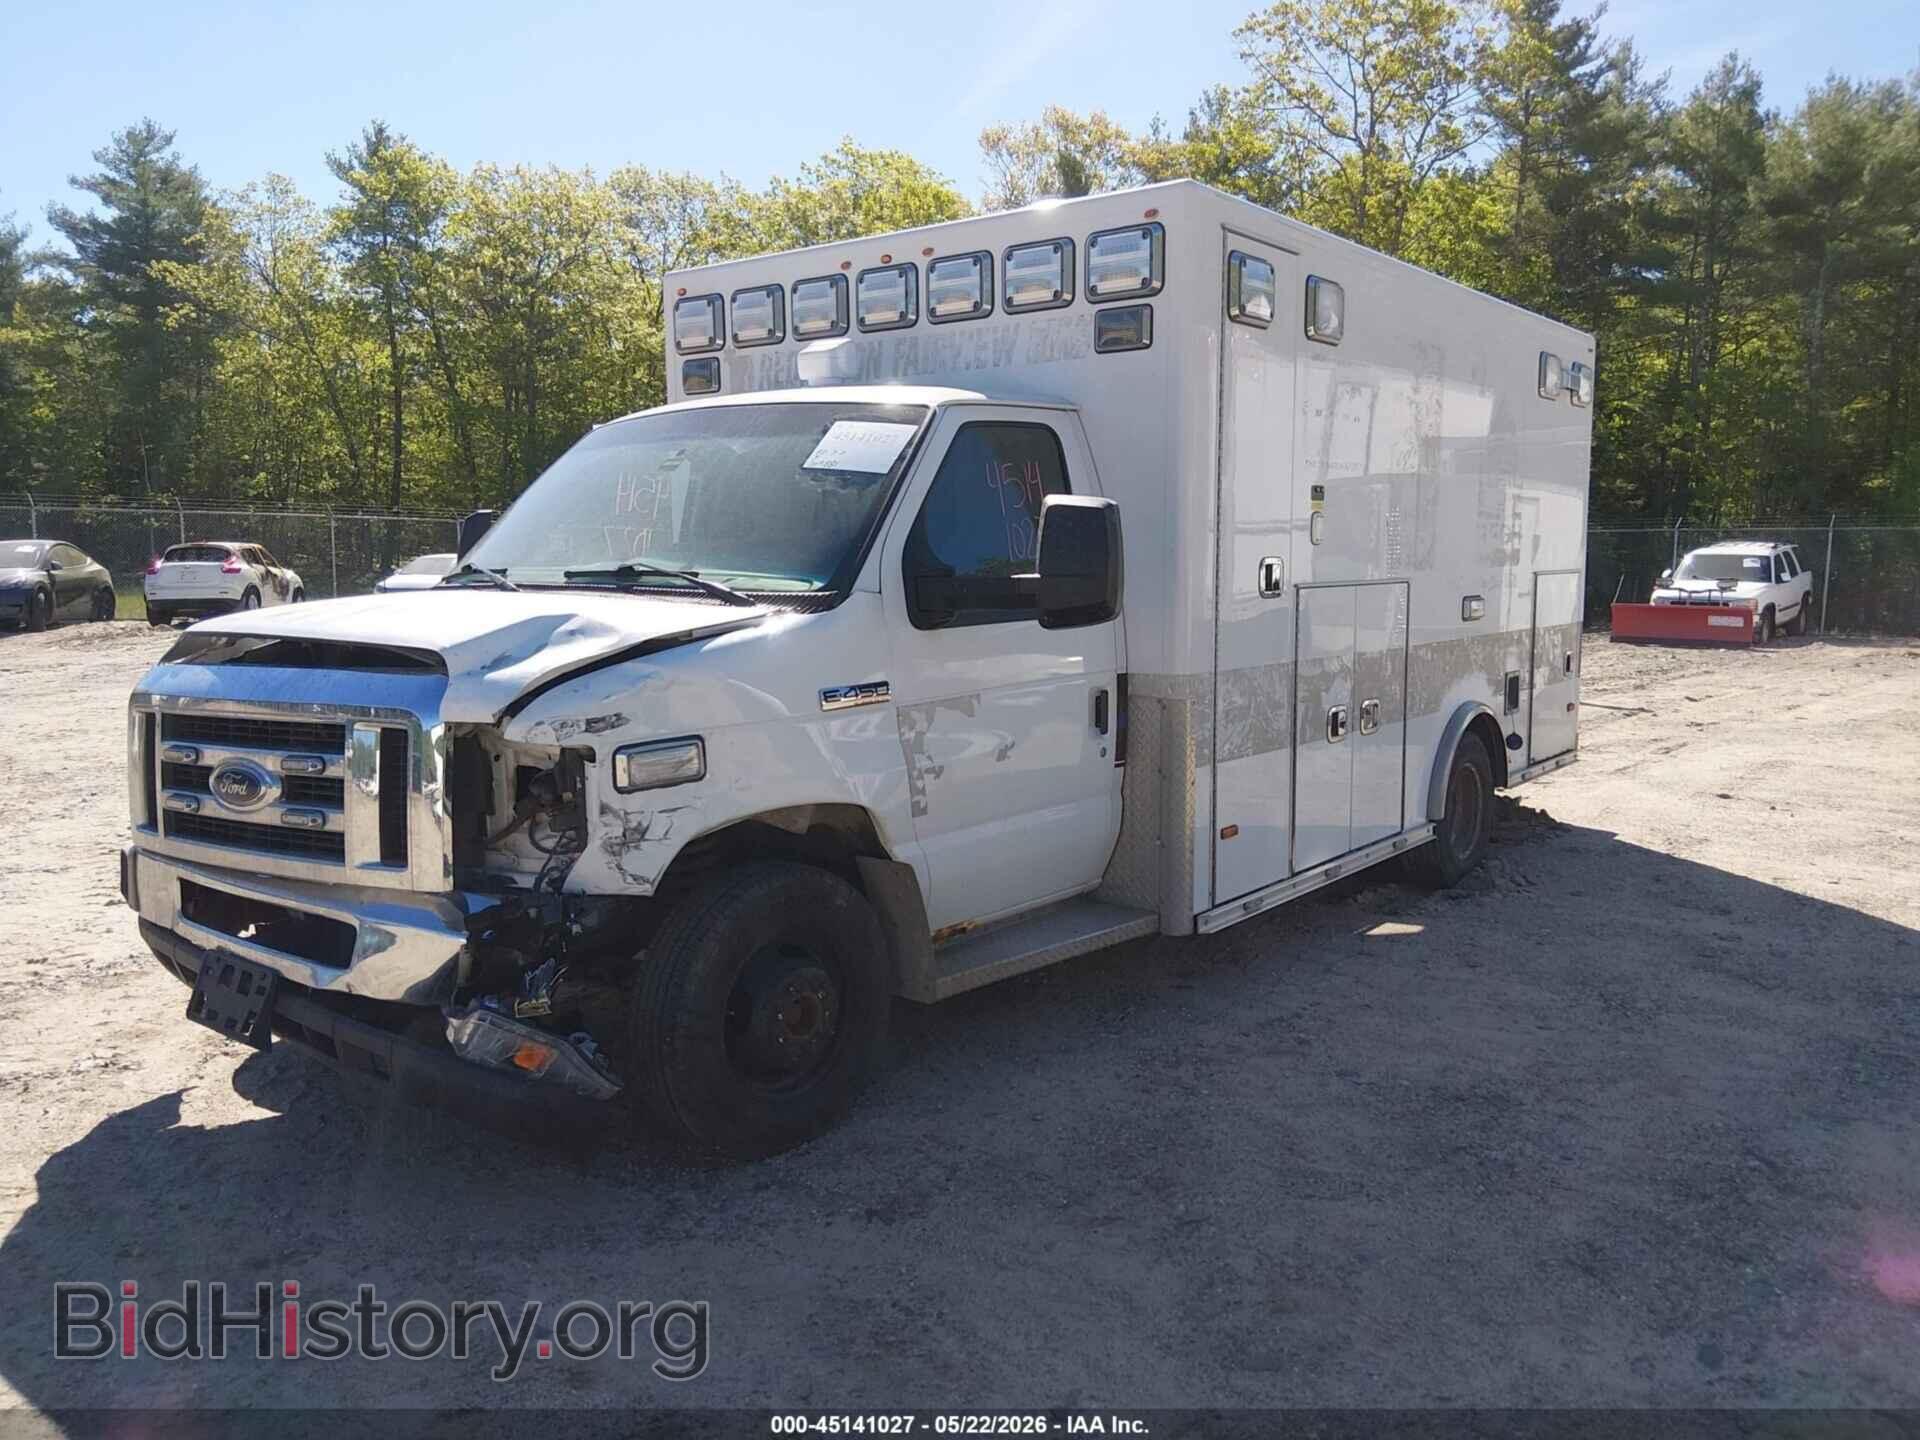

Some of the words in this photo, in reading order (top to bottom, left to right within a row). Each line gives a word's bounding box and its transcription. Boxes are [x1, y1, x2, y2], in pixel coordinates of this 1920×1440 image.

[985, 459, 1045, 517] 4514
[1006, 515, 1040, 561] 102
[219, 772, 249, 796] Ford
